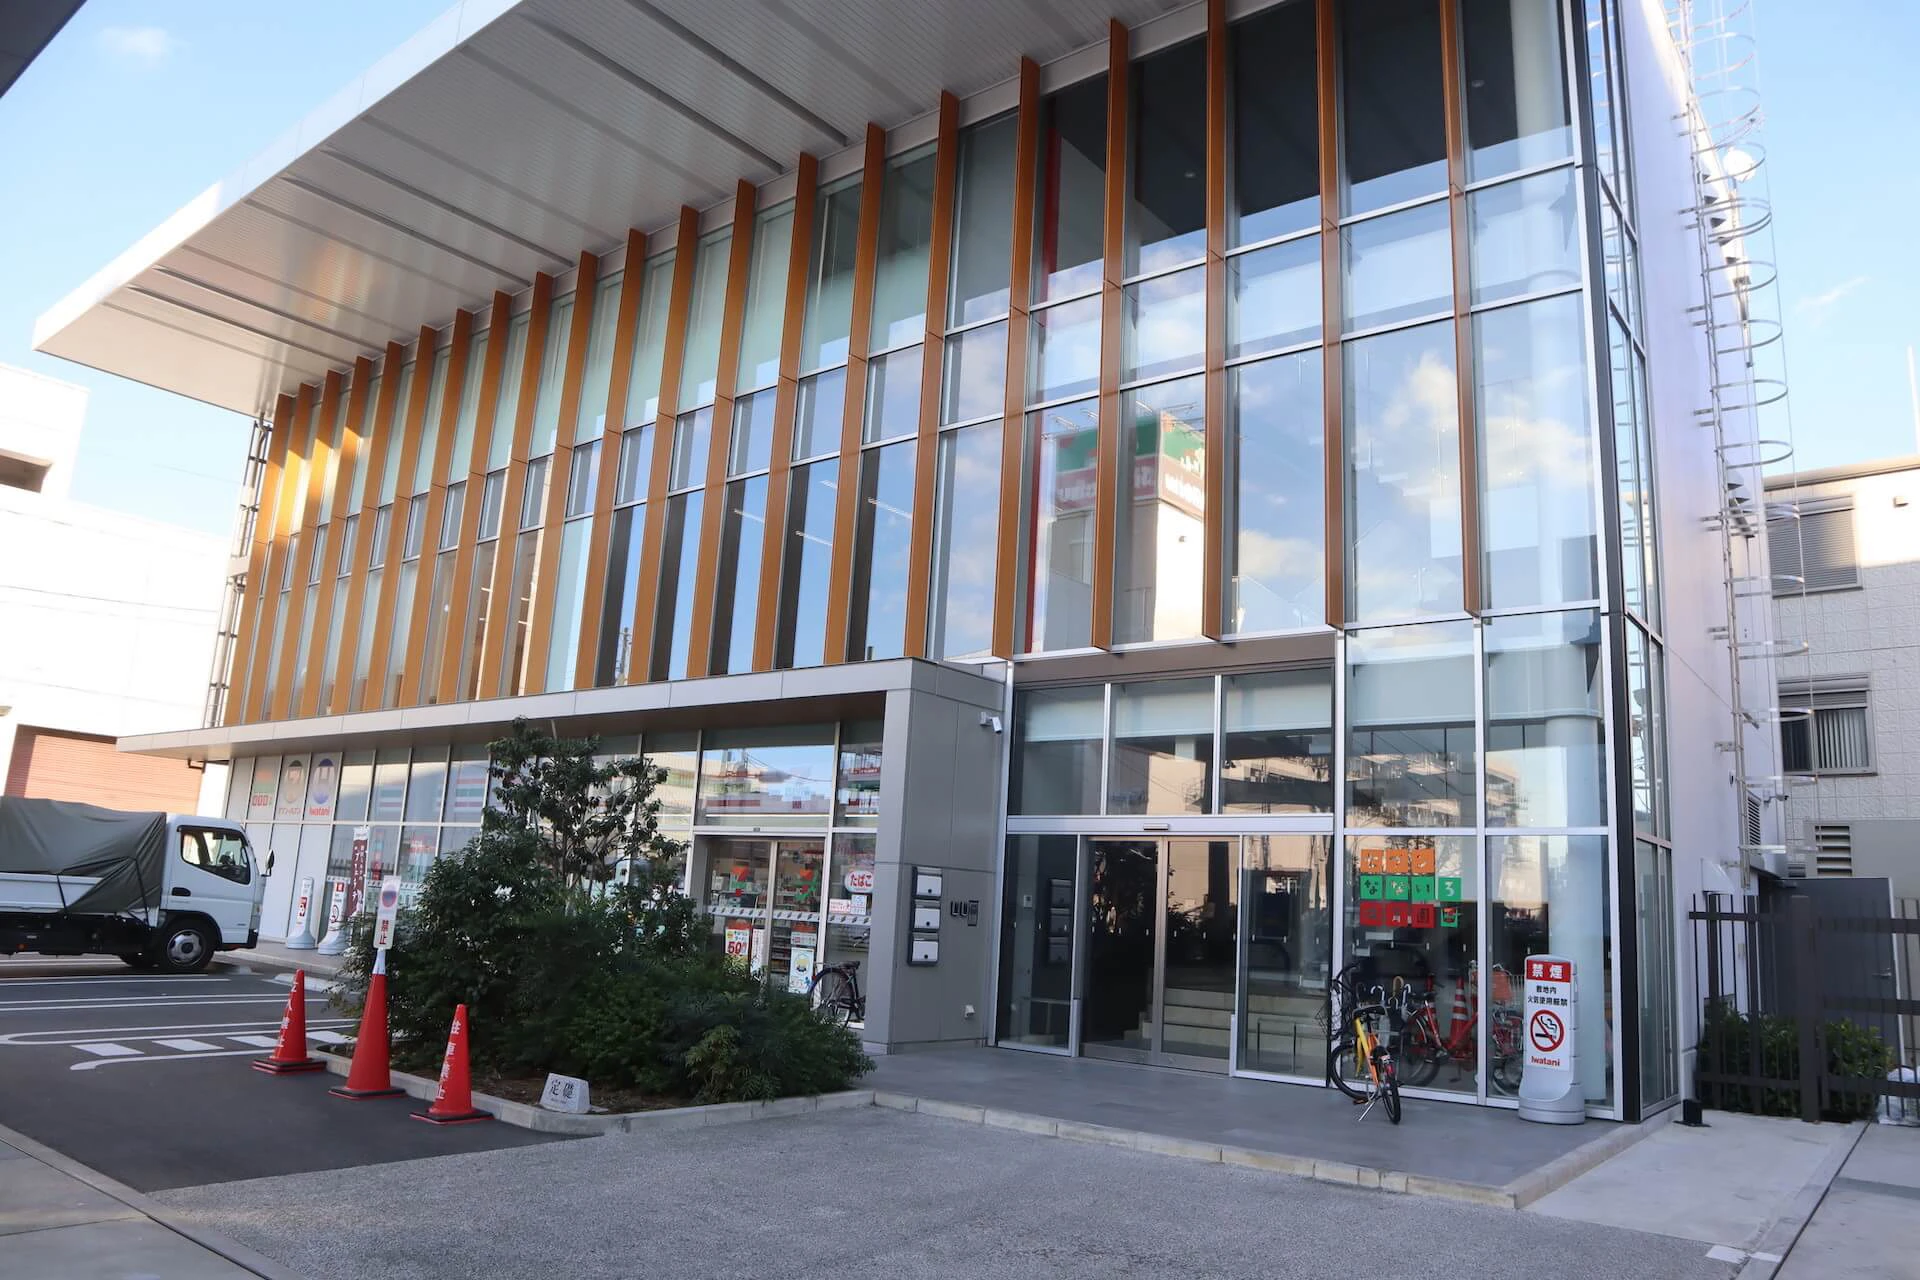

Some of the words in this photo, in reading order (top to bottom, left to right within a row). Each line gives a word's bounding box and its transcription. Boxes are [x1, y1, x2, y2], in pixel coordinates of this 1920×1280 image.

[850, 873, 873, 888] たばこ
[1532, 963, 1563, 979] 禁煙
[1531, 1055, 1560, 1066] Iwatani
[550, 1079, 576, 1099] 定礎
